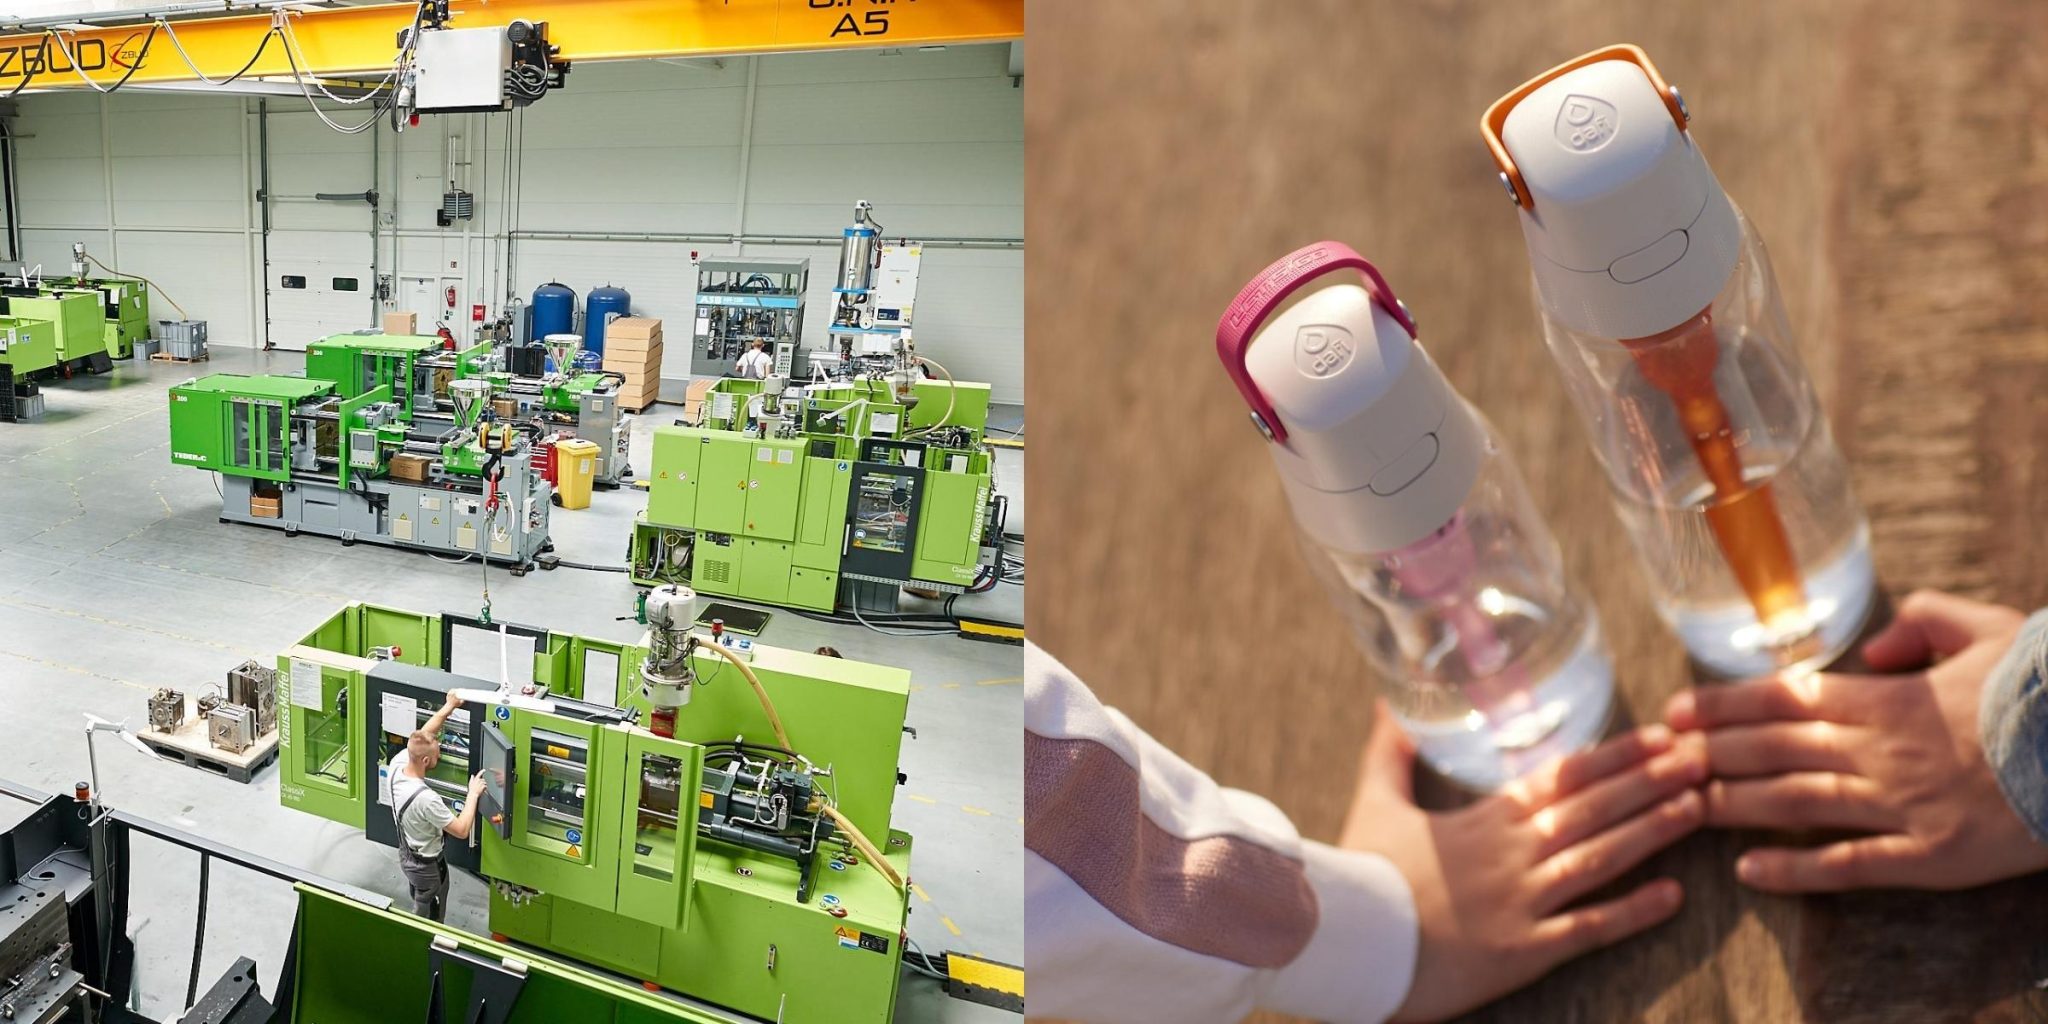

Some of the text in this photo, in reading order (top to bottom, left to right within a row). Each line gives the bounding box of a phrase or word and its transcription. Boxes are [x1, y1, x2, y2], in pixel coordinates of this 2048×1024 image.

[829, 10, 889, 37] A5
[0, 38, 105, 77] ZBUD
[1570, 115, 1615, 150] dafi
[1311, 338, 1352, 377] dafi
